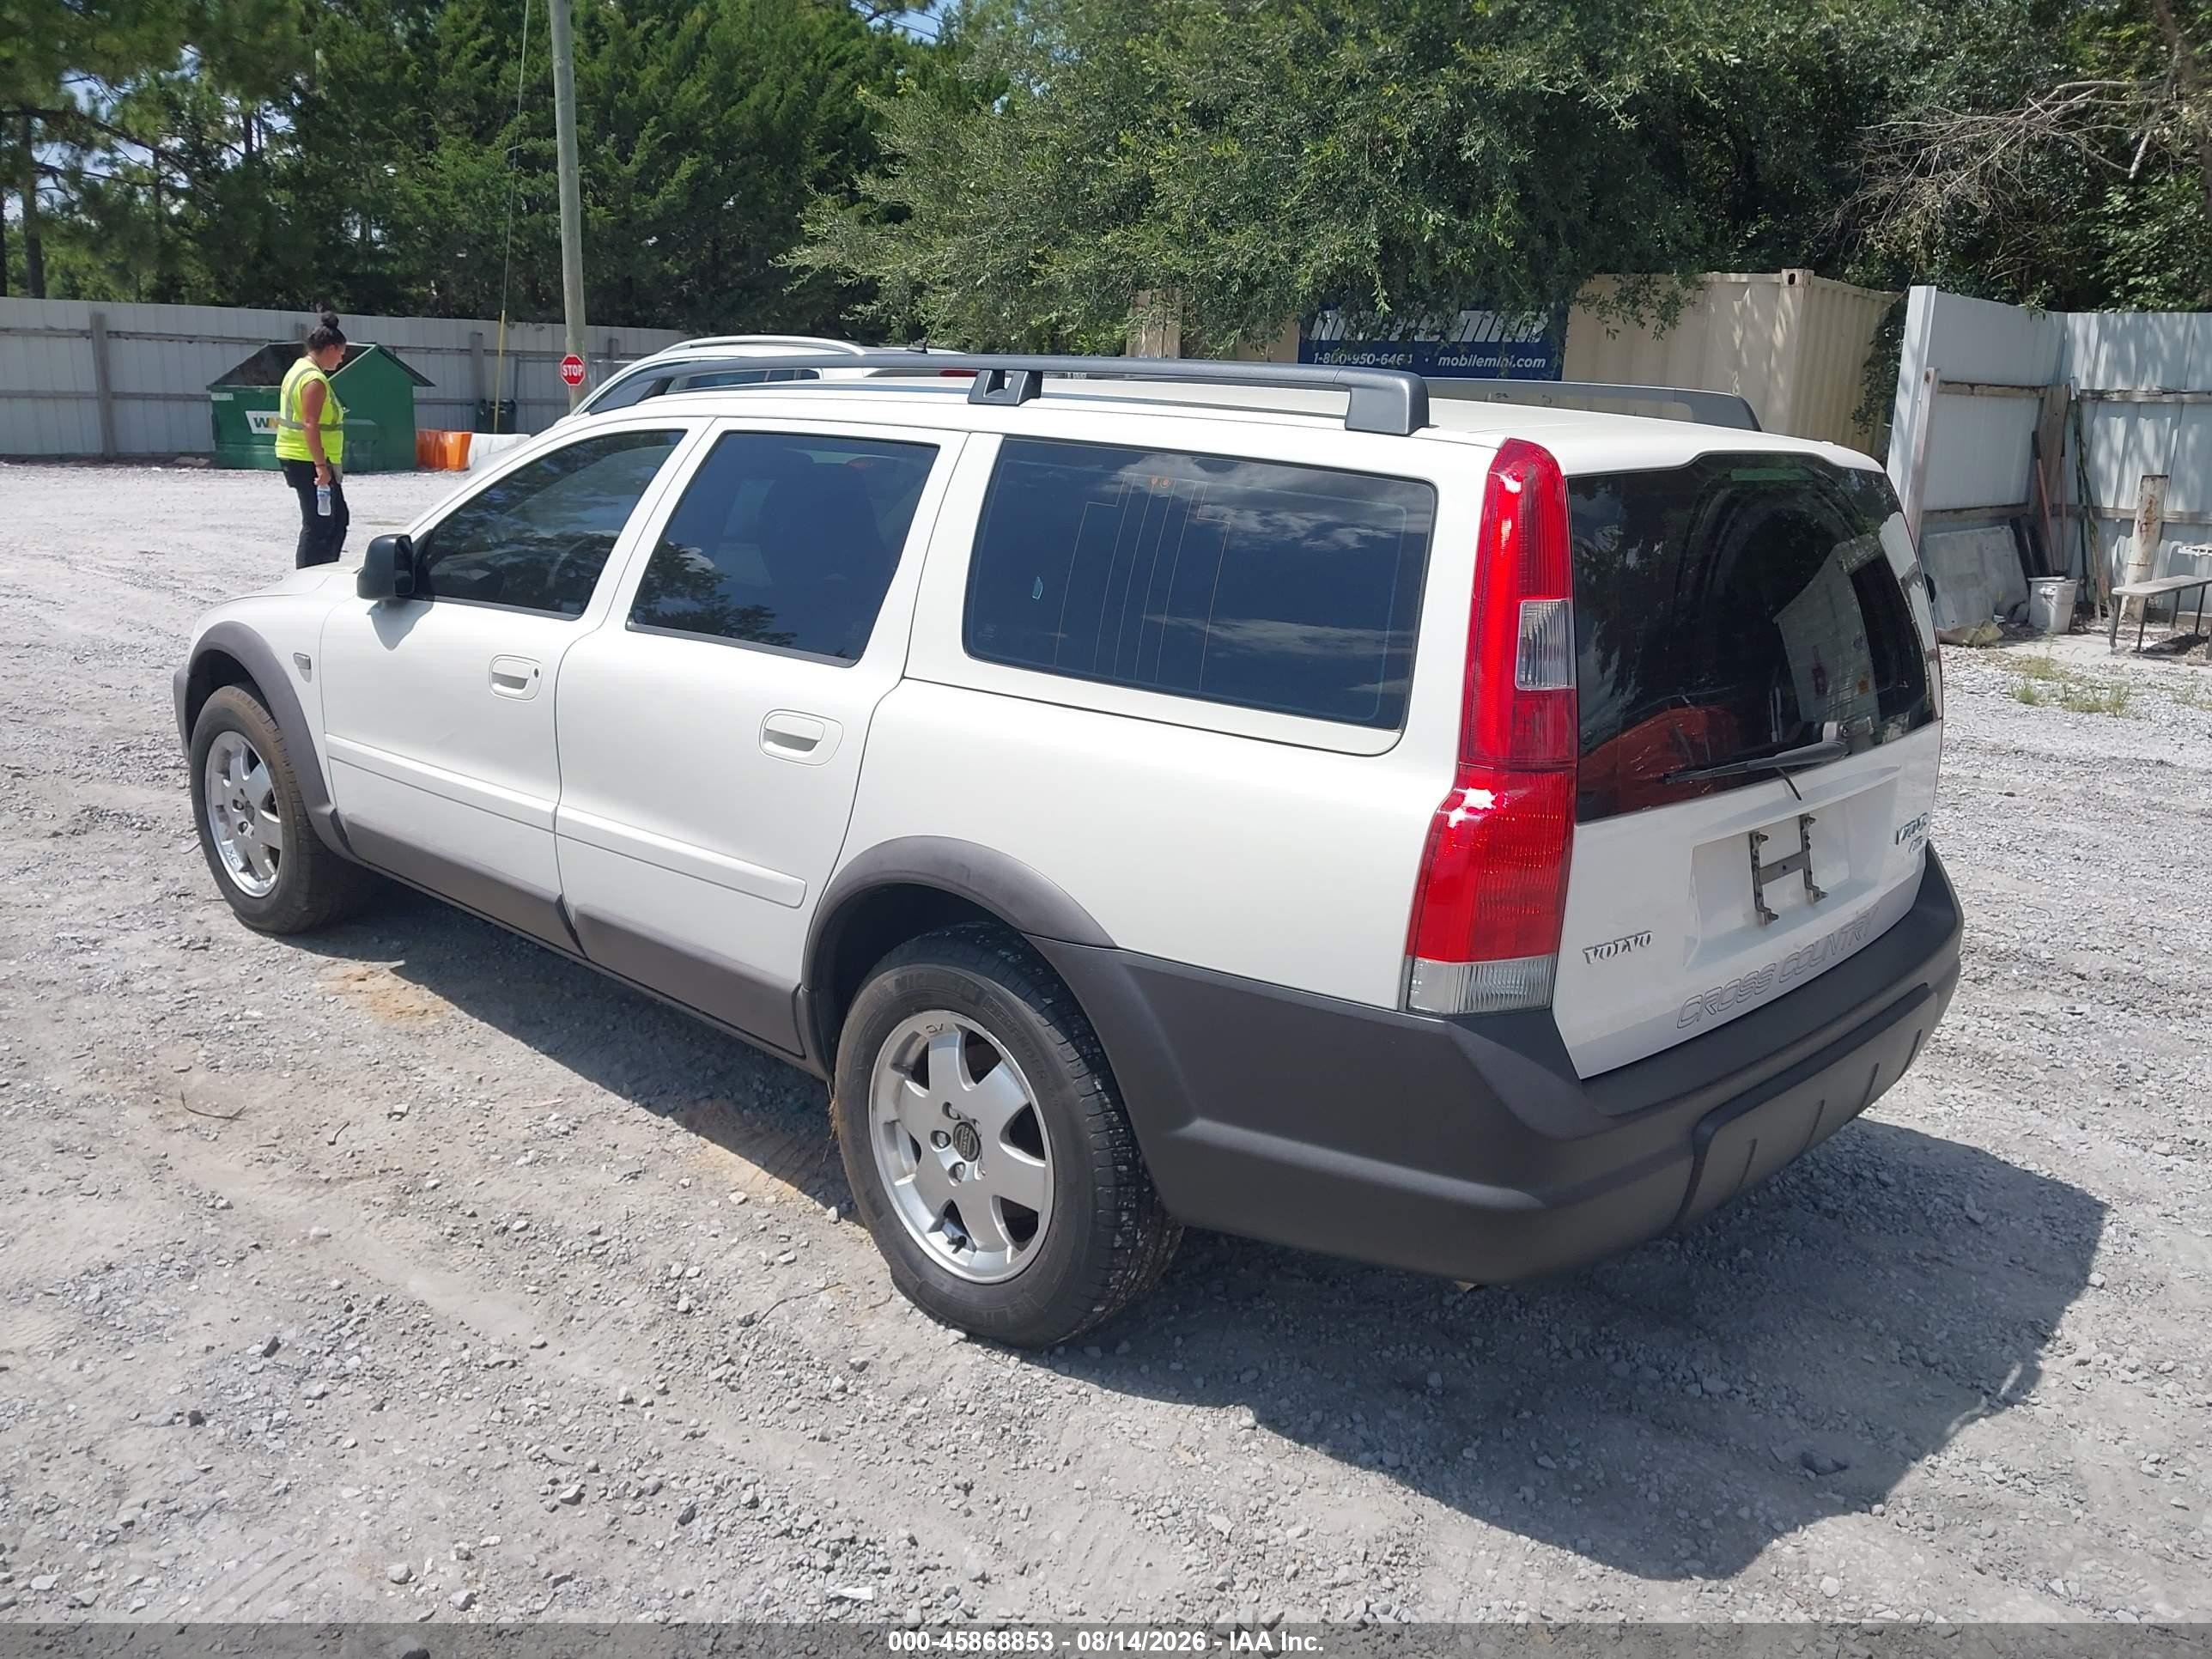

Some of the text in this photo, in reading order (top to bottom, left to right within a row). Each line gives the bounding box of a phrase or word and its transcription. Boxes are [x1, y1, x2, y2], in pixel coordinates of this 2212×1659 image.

[562, 364, 583, 377] STOP
[1437, 353, 1546, 368] mobilemini.com
[1583, 930, 1654, 963] VOLVO
[1676, 962, 1776, 1030] CROSS
